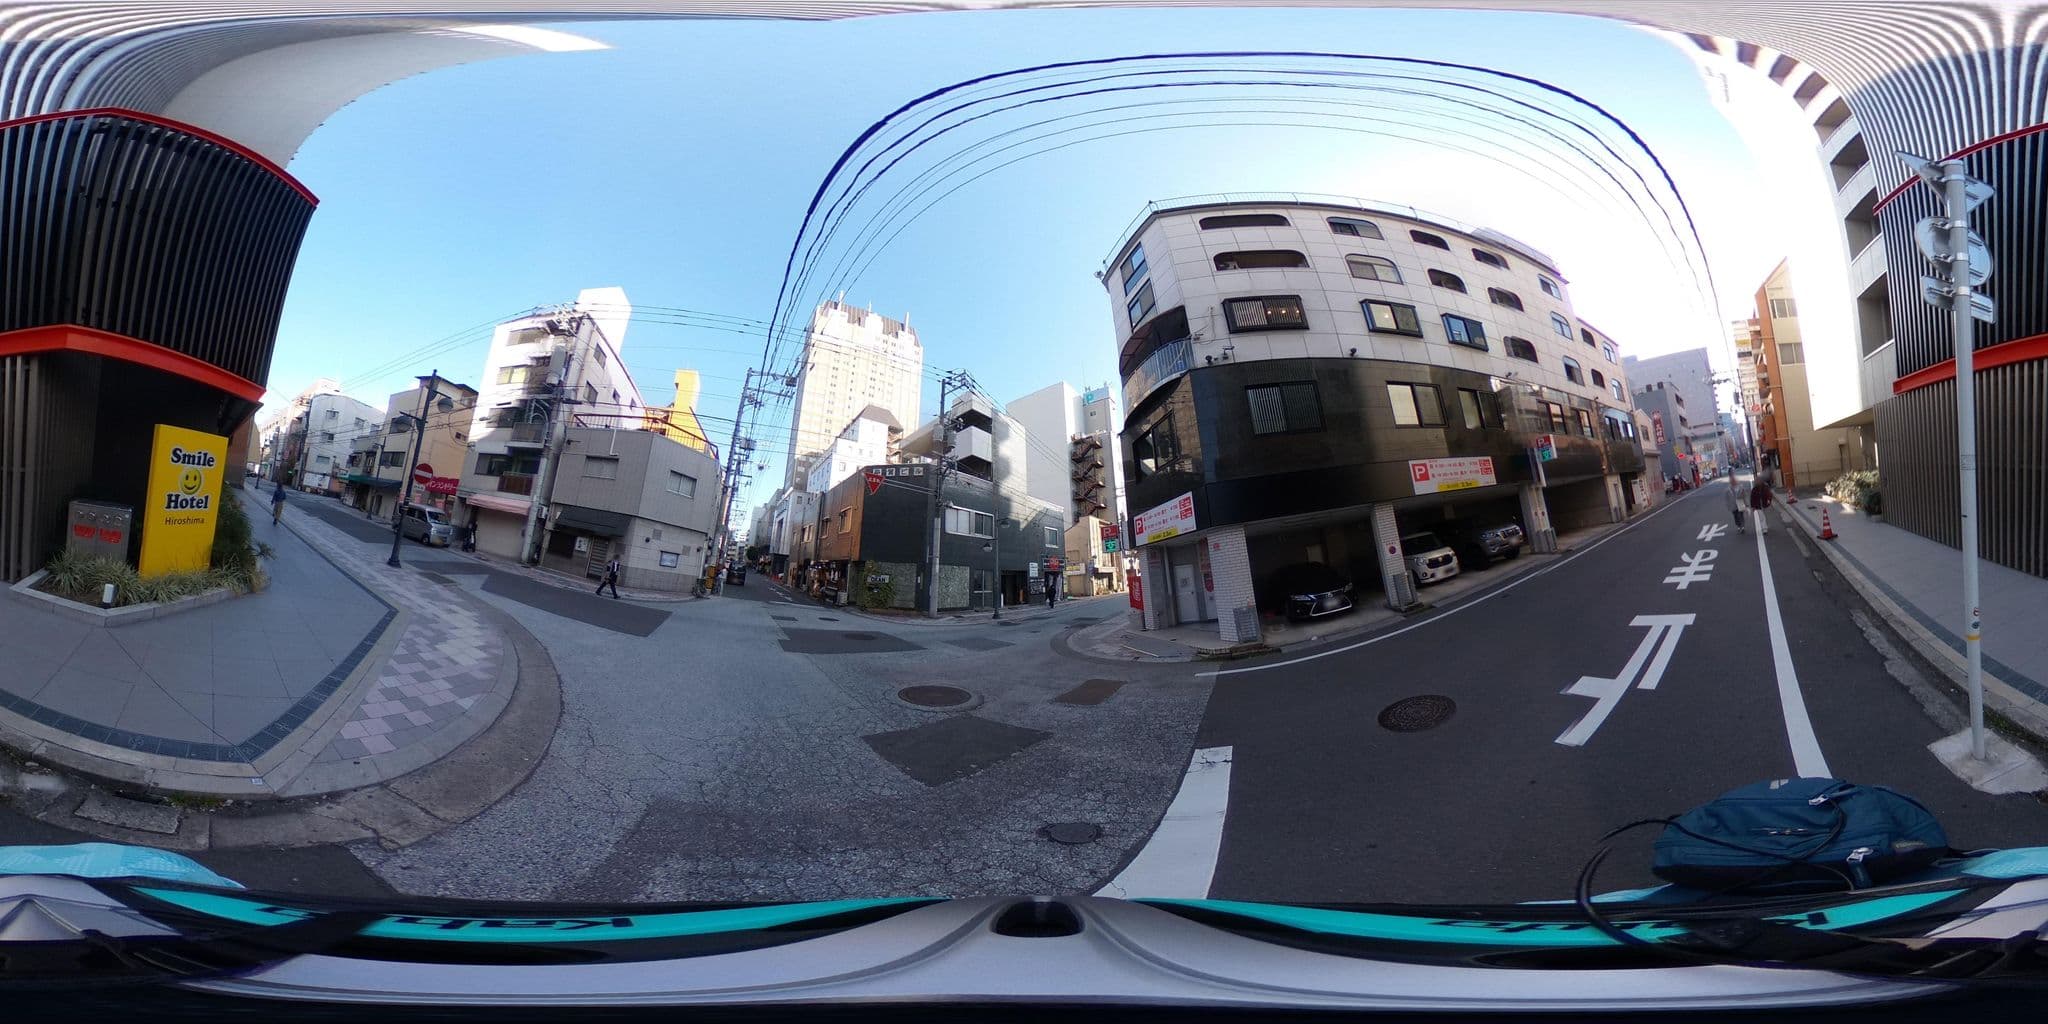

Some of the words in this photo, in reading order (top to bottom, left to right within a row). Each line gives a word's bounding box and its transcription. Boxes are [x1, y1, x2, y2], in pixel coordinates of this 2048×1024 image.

[171, 447, 215, 467] Smile
[1414, 465, 1426, 480] P
[165, 493, 209, 509] Hotel
[164, 516, 205, 526] Hiroshima
[1554, 523, 1728, 746] 止まれ
